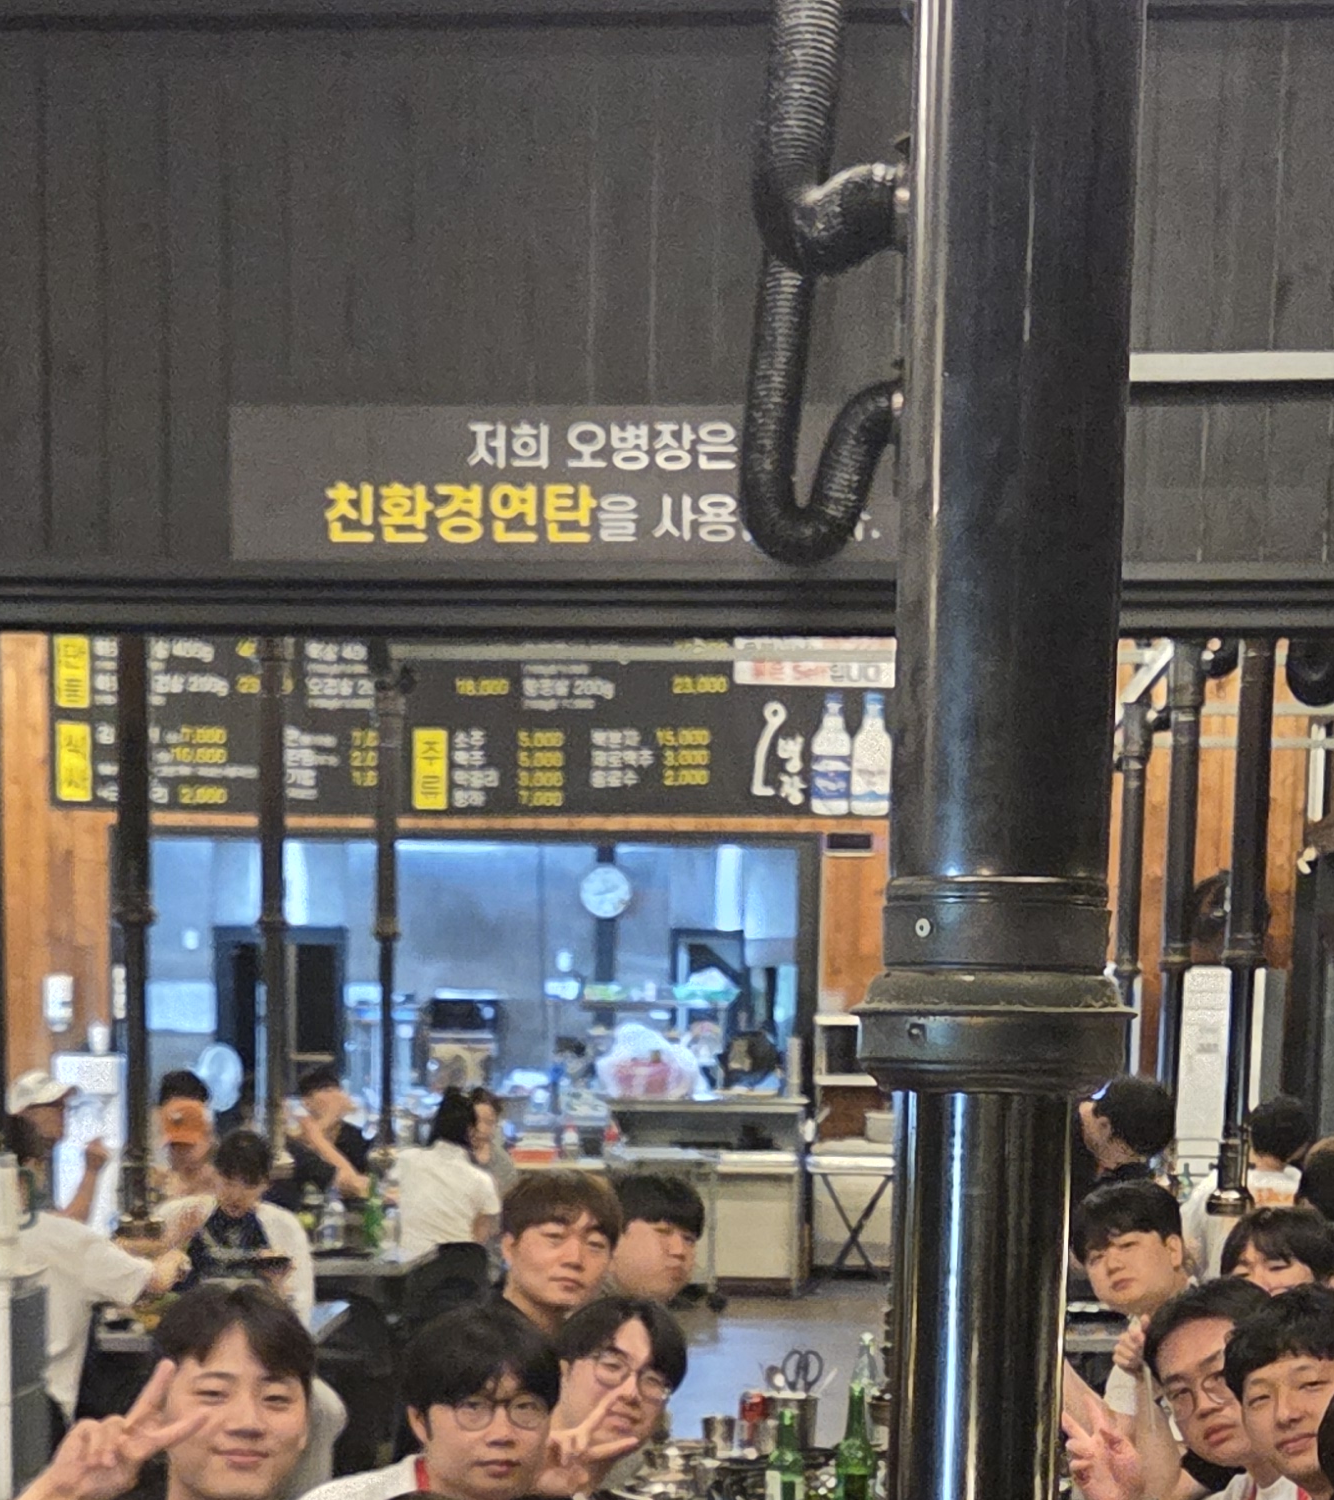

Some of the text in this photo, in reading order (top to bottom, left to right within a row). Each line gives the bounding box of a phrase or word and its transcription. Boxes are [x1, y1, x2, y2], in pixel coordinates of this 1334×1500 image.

[467, 420, 738, 471] 저희 오병장은
[325, 480, 639, 544] 친환경연탄을
